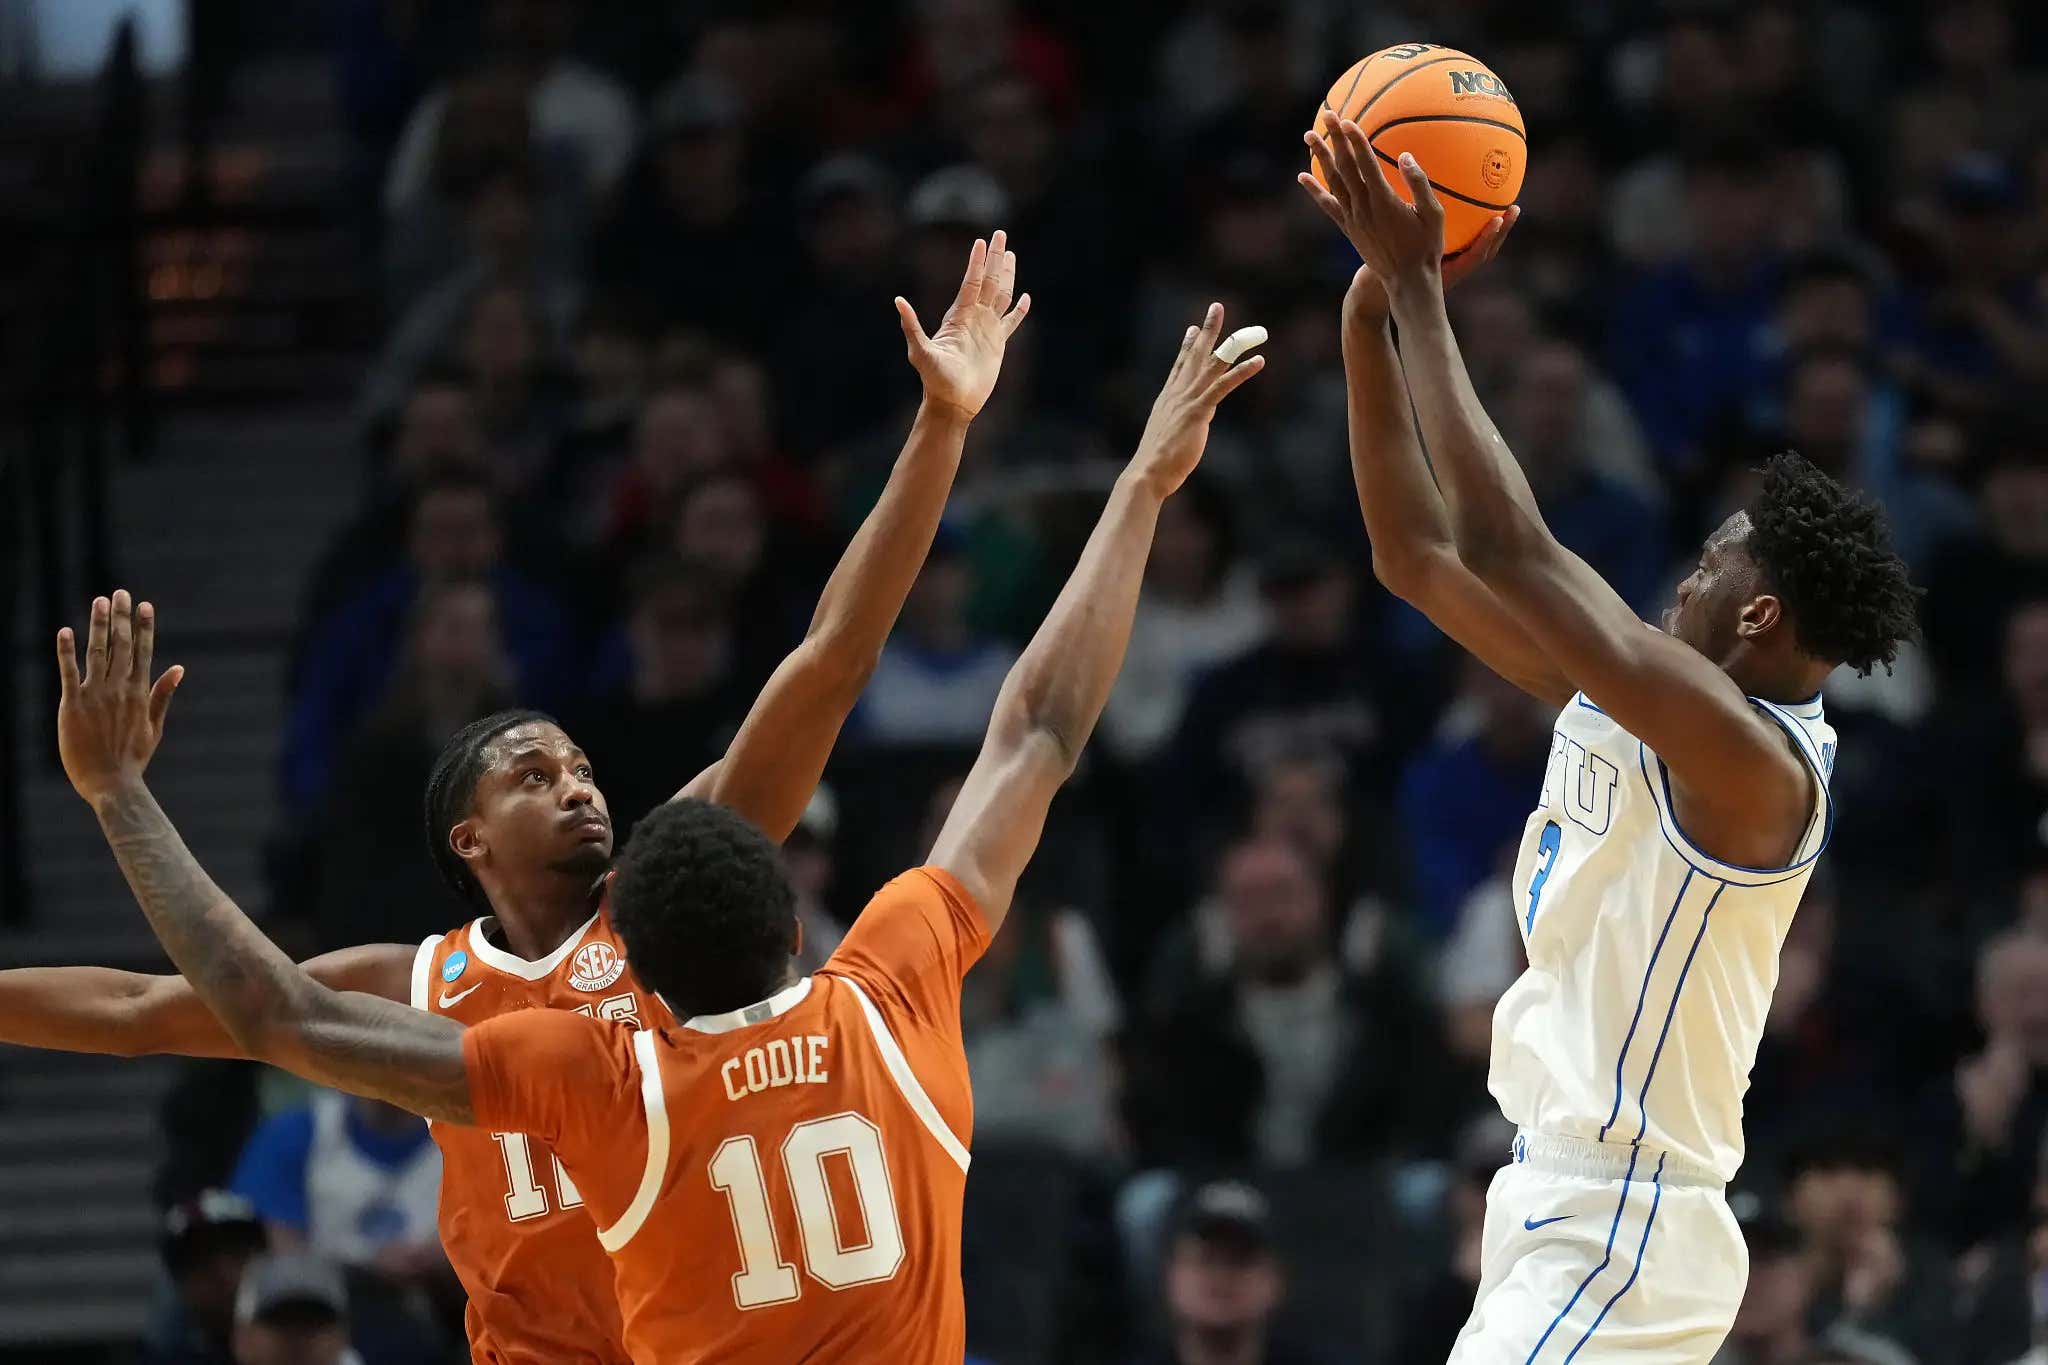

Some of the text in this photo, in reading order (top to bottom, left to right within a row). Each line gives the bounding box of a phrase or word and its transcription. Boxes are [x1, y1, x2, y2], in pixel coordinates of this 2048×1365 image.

[575, 969, 620, 991] GRADUATE
[576, 944, 615, 980] SEC
[721, 1036, 829, 1101] CODIE
[708, 1111, 905, 1311] 10
